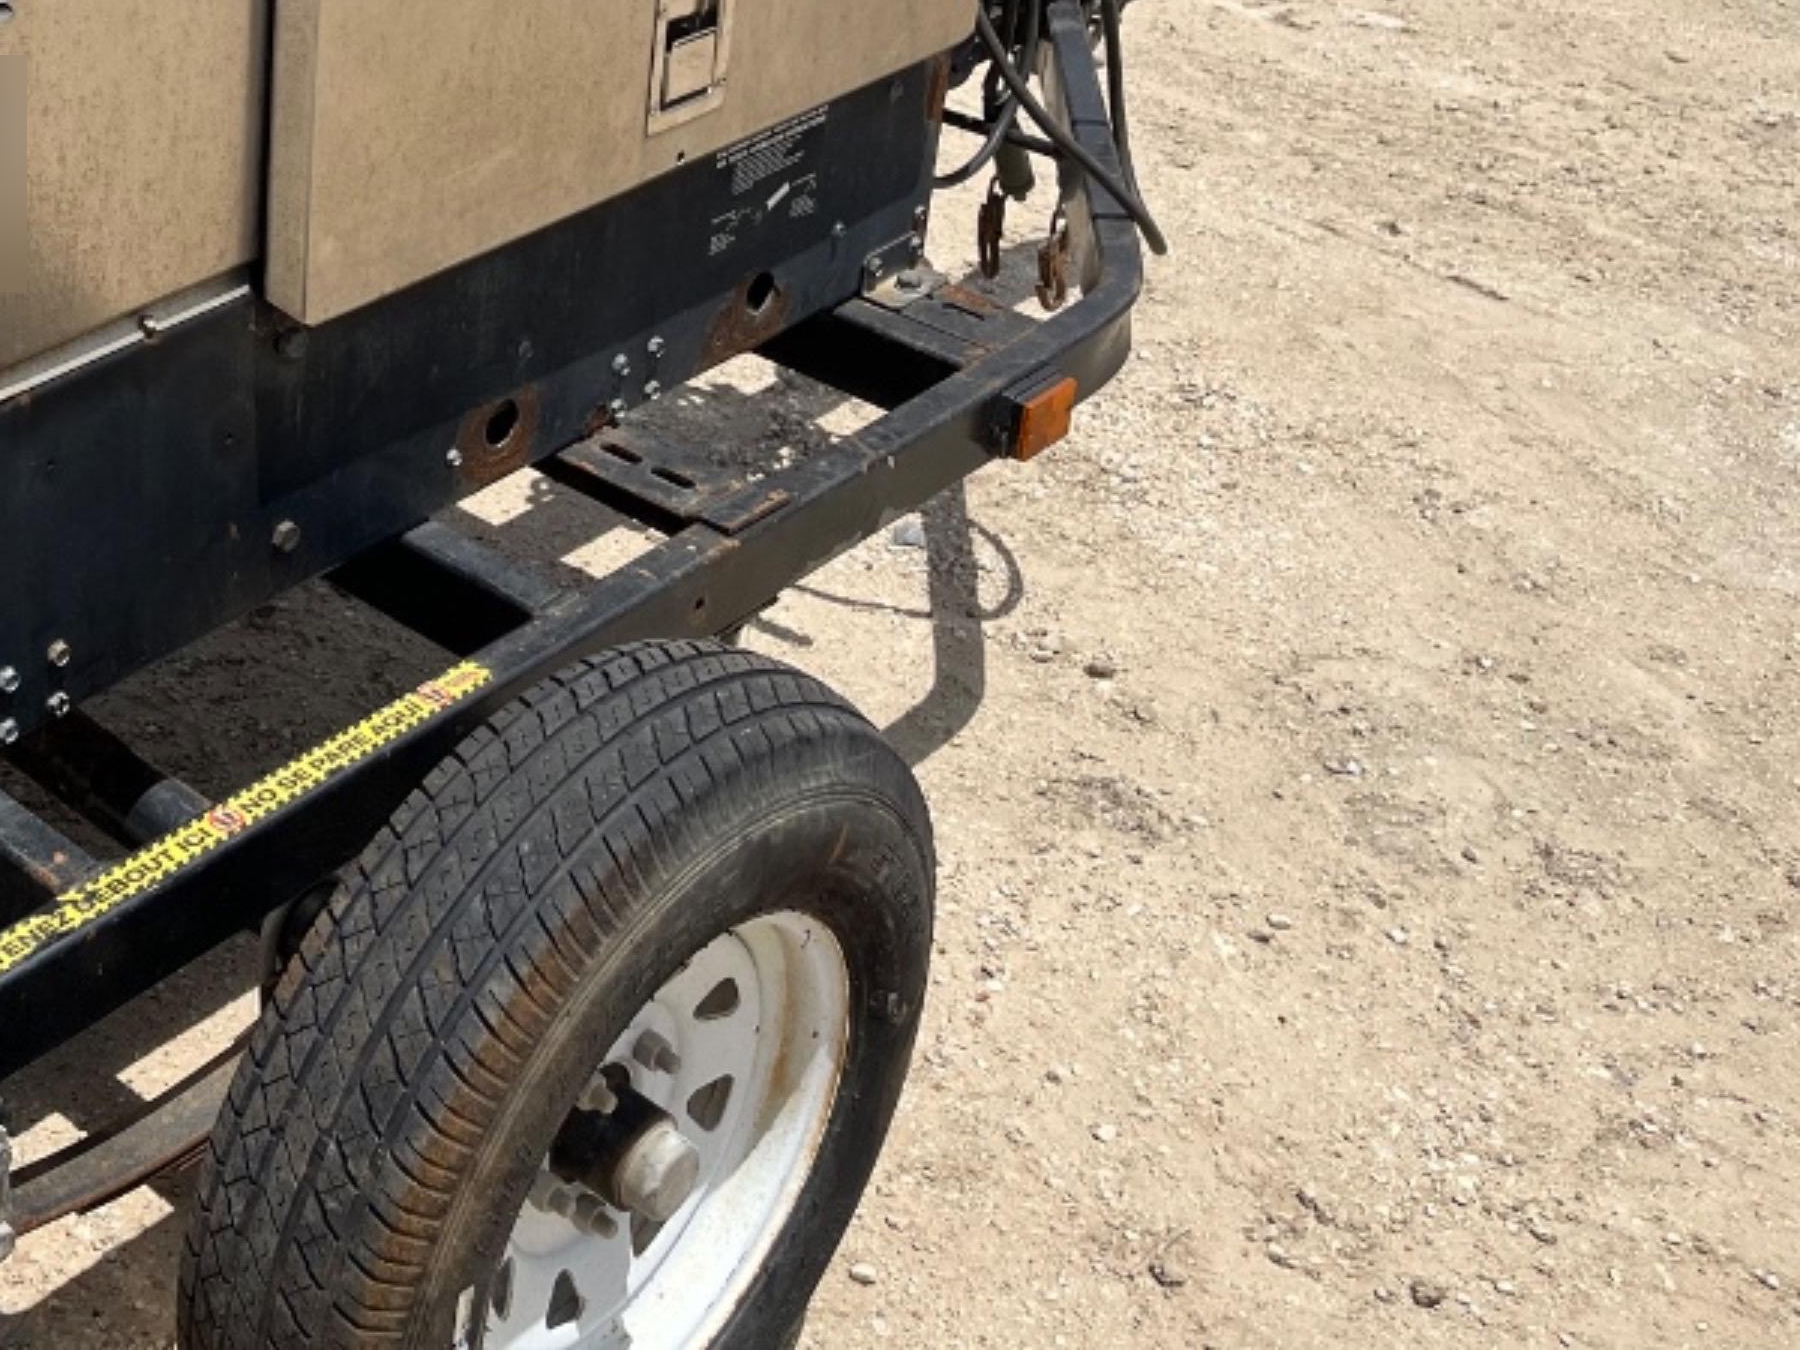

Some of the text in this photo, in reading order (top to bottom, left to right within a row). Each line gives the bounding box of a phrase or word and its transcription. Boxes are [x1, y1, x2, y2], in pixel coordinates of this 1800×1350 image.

[239, 787, 277, 814] NO
[276, 766, 313, 790] SE
[309, 730, 373, 771] PARE
[176, 827, 214, 853] ICI
